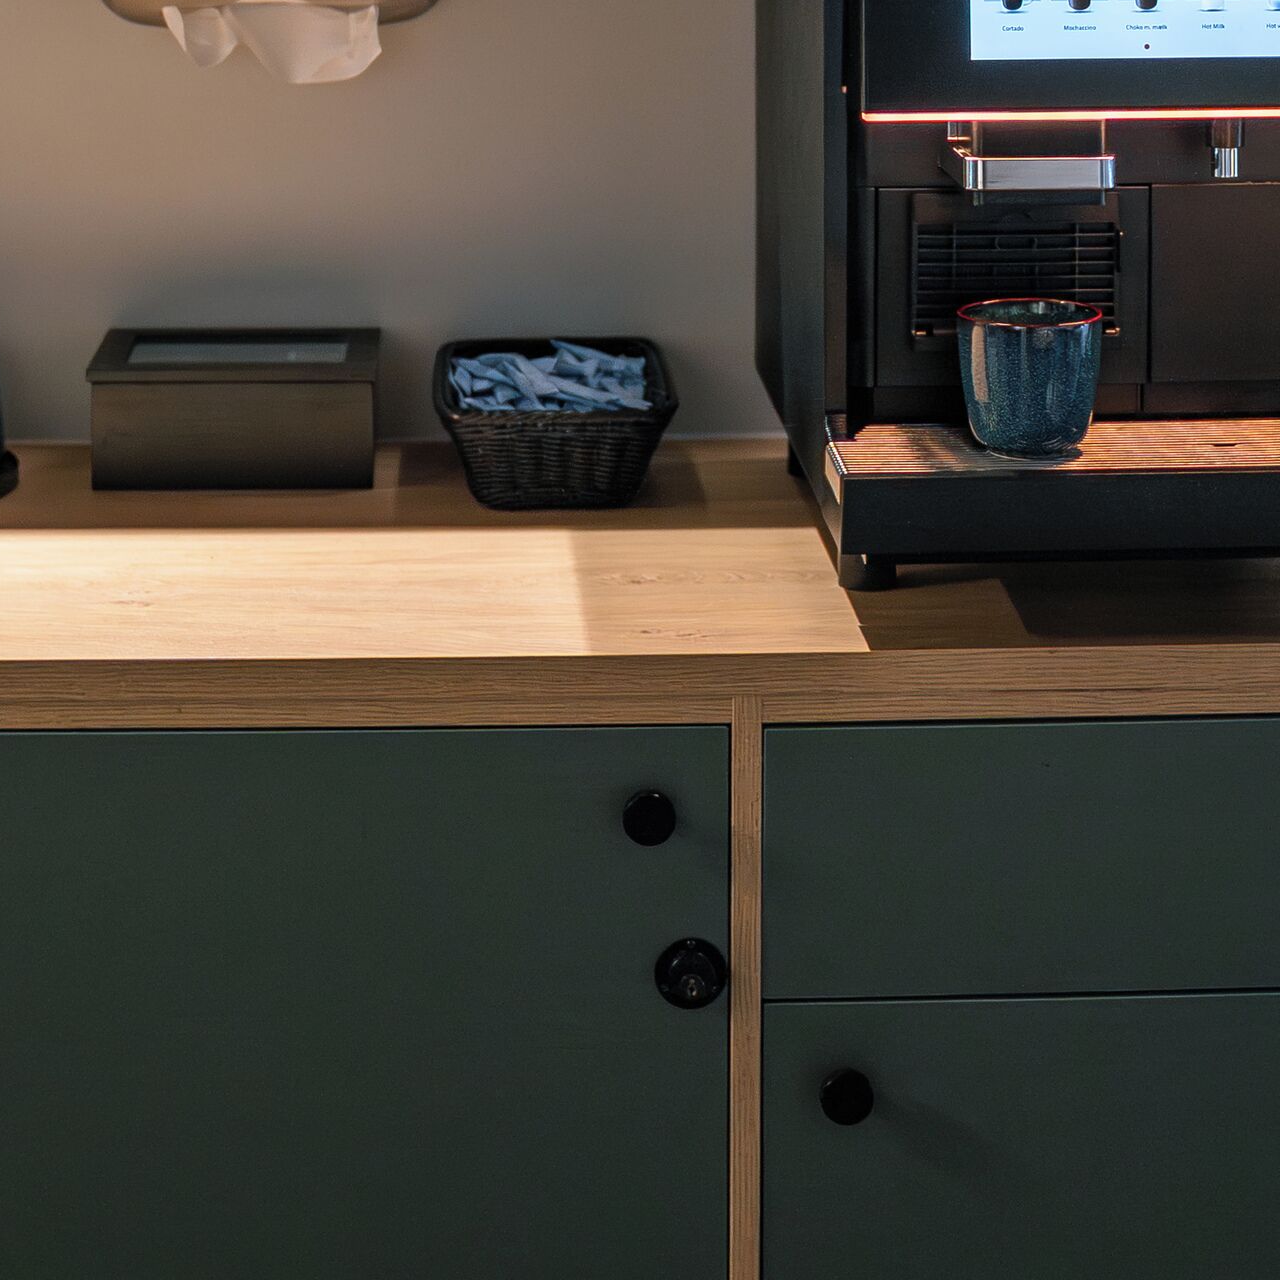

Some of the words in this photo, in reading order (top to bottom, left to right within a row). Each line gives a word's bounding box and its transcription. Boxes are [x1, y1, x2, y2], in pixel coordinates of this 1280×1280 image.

[1125, 23, 1143, 31] Choko
[1201, 22, 1211, 30] Hot
[1212, 22, 1225, 30] Milk
